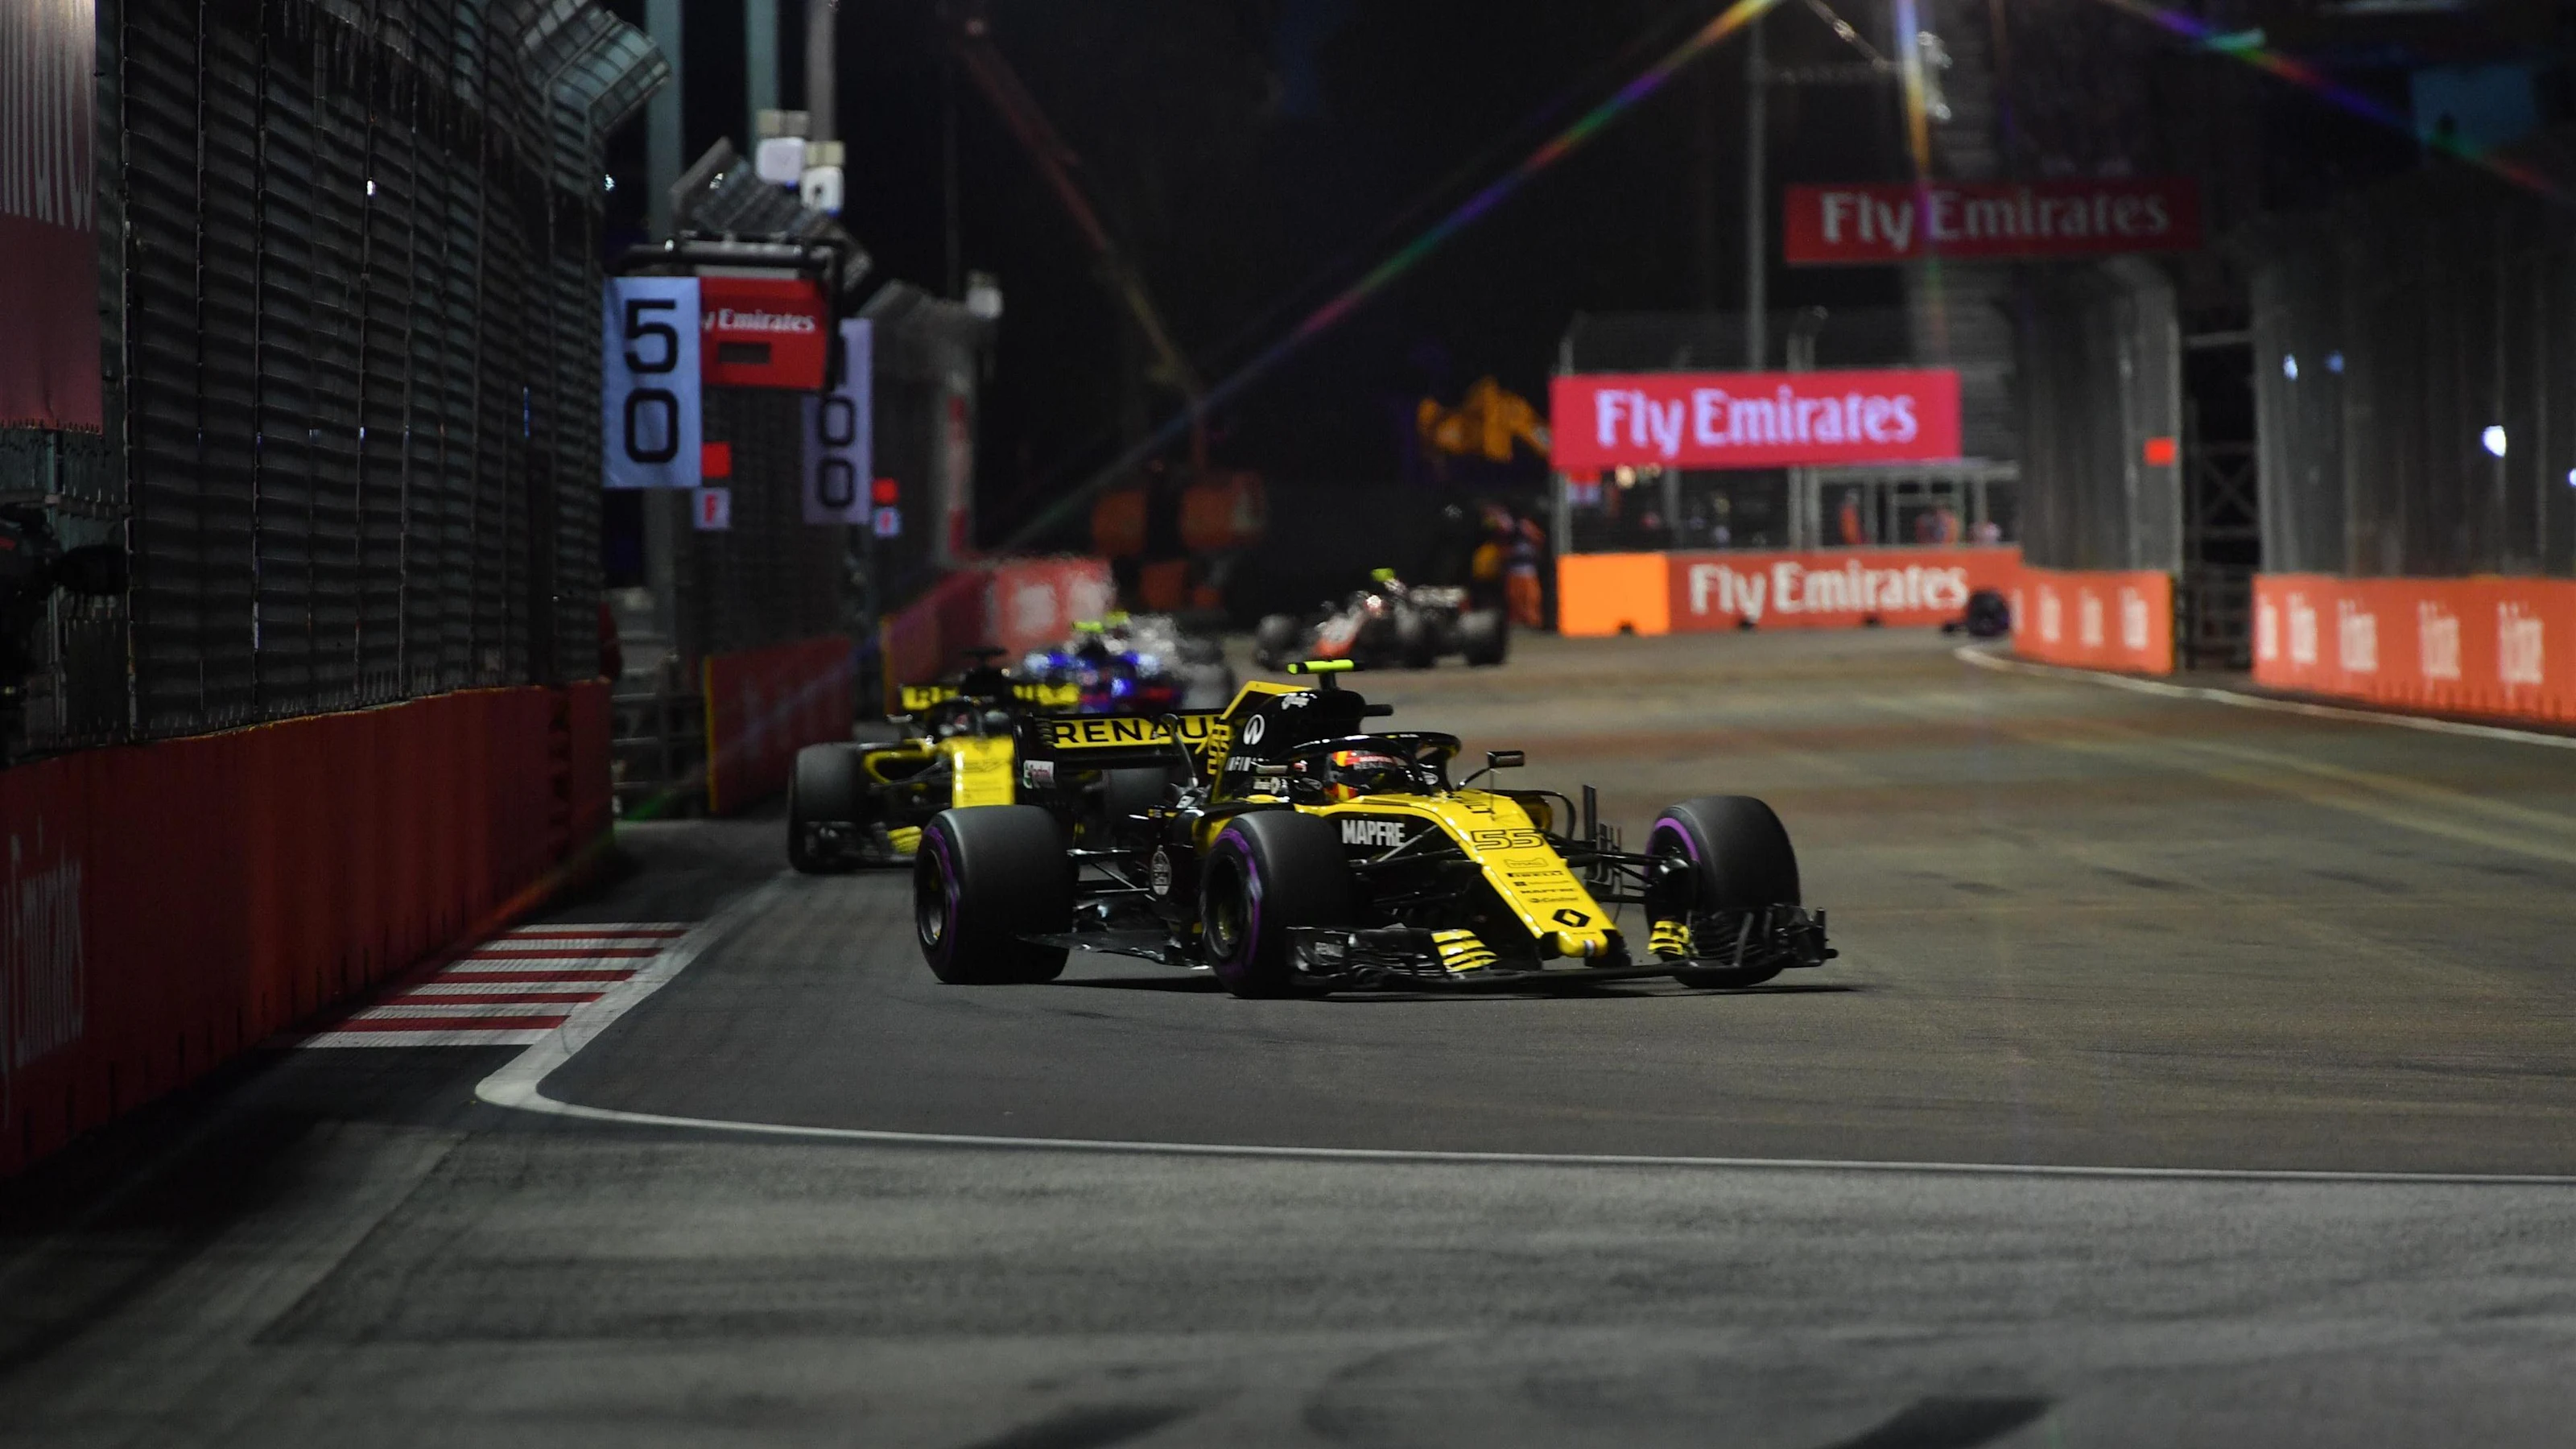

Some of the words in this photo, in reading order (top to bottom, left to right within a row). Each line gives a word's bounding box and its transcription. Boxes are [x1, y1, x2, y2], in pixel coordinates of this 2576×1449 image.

[1820, 192, 1914, 252] Fly
[1930, 186, 2169, 242] Emirates
[717, 308, 815, 334] Emirates
[1595, 388, 1685, 459] Fly
[1692, 383, 1918, 446] Emirates
[1688, 564, 1766, 622] Fly
[1773, 559, 1969, 614] Emirates
[1342, 819, 1406, 846] MAPFRE
[1469, 827, 1545, 852] 55
